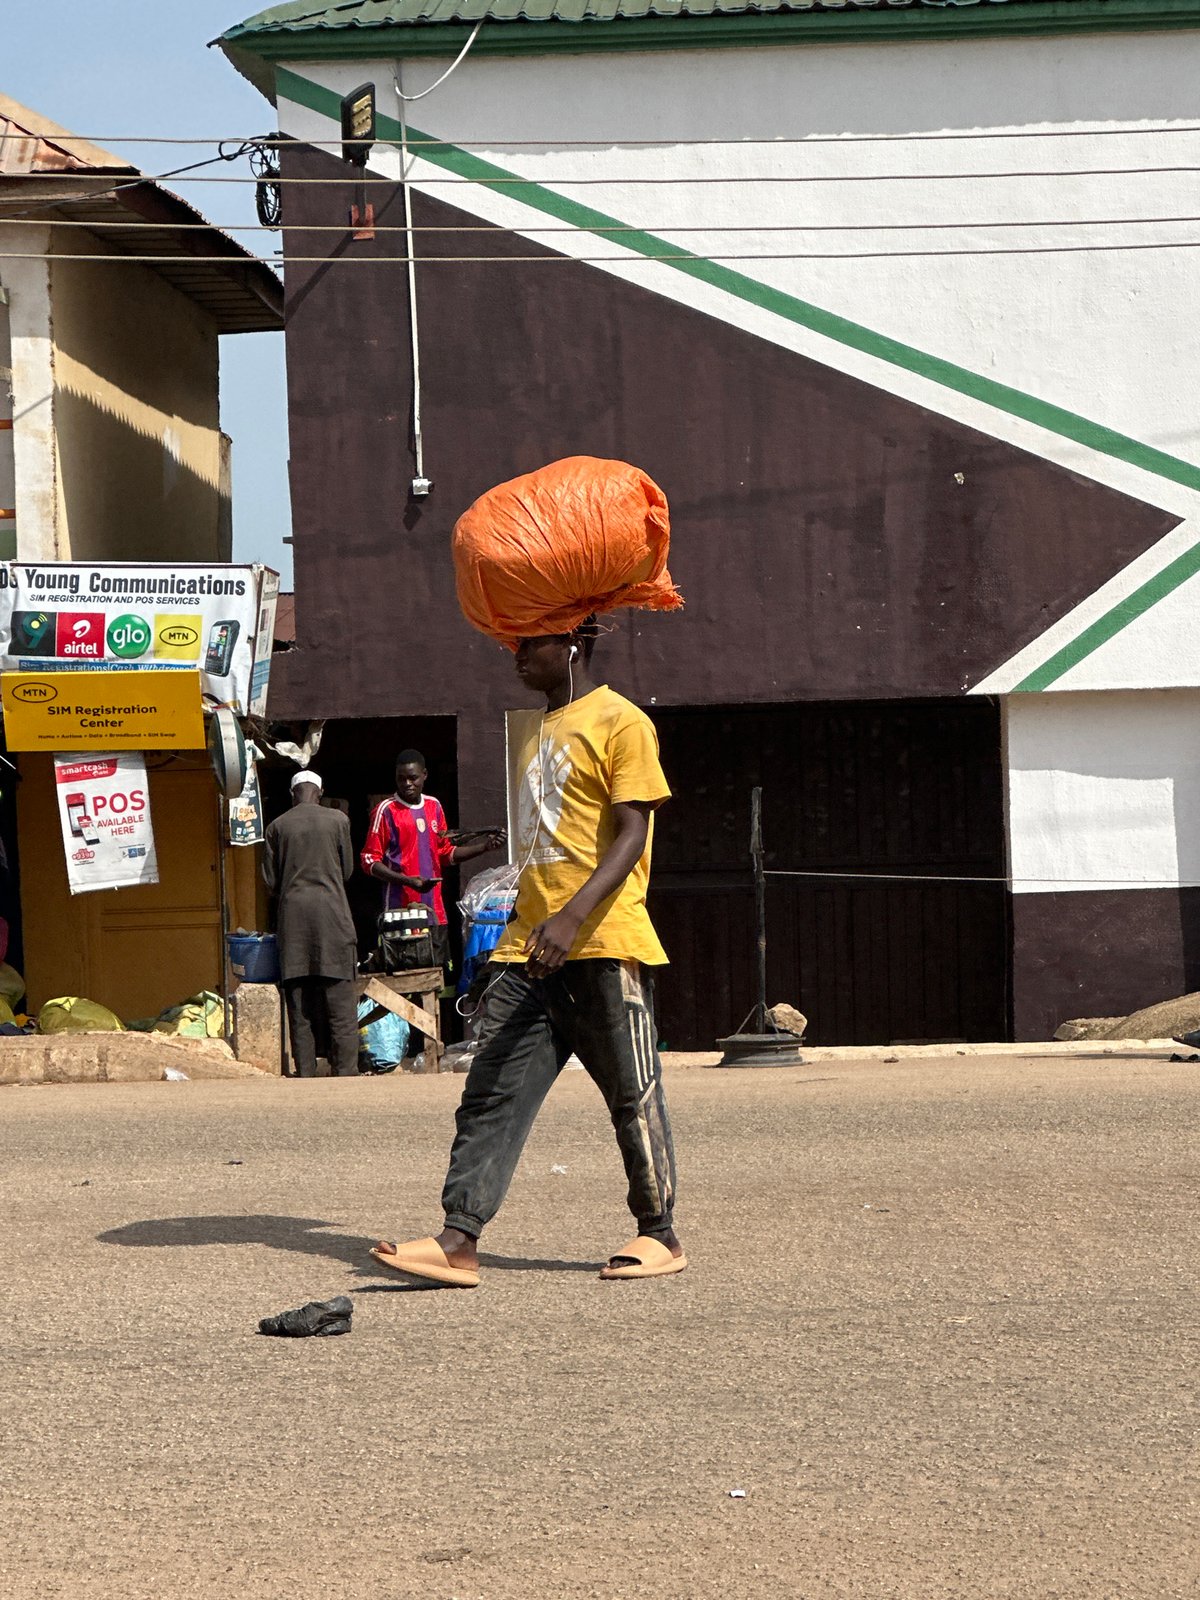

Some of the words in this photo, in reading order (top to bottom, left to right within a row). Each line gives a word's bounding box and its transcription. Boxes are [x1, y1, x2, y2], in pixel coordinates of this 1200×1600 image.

[25, 568, 80, 594] Young
[89, 572, 246, 596] Communications
[29, 594, 46, 602] SIM
[47, 594, 112, 603] REGISTRATION
[114, 596, 133, 604] AND
[135, 596, 154, 604] POS
[155, 596, 200, 605] SERVICES
[113, 624, 145, 649] glo
[168, 632, 189, 641] MTN
[64, 641, 98, 655] airtel
[23, 689, 47, 697] MTN
[47, 706, 71, 715] SIM
[75, 705, 157, 716] Registration
[79, 718, 124, 728] Center
[61, 762, 108, 775] smartcash
[92, 790, 145, 816] POS
[97, 814, 145, 829] AVAILABLE
[111, 825, 135, 836] HERE
